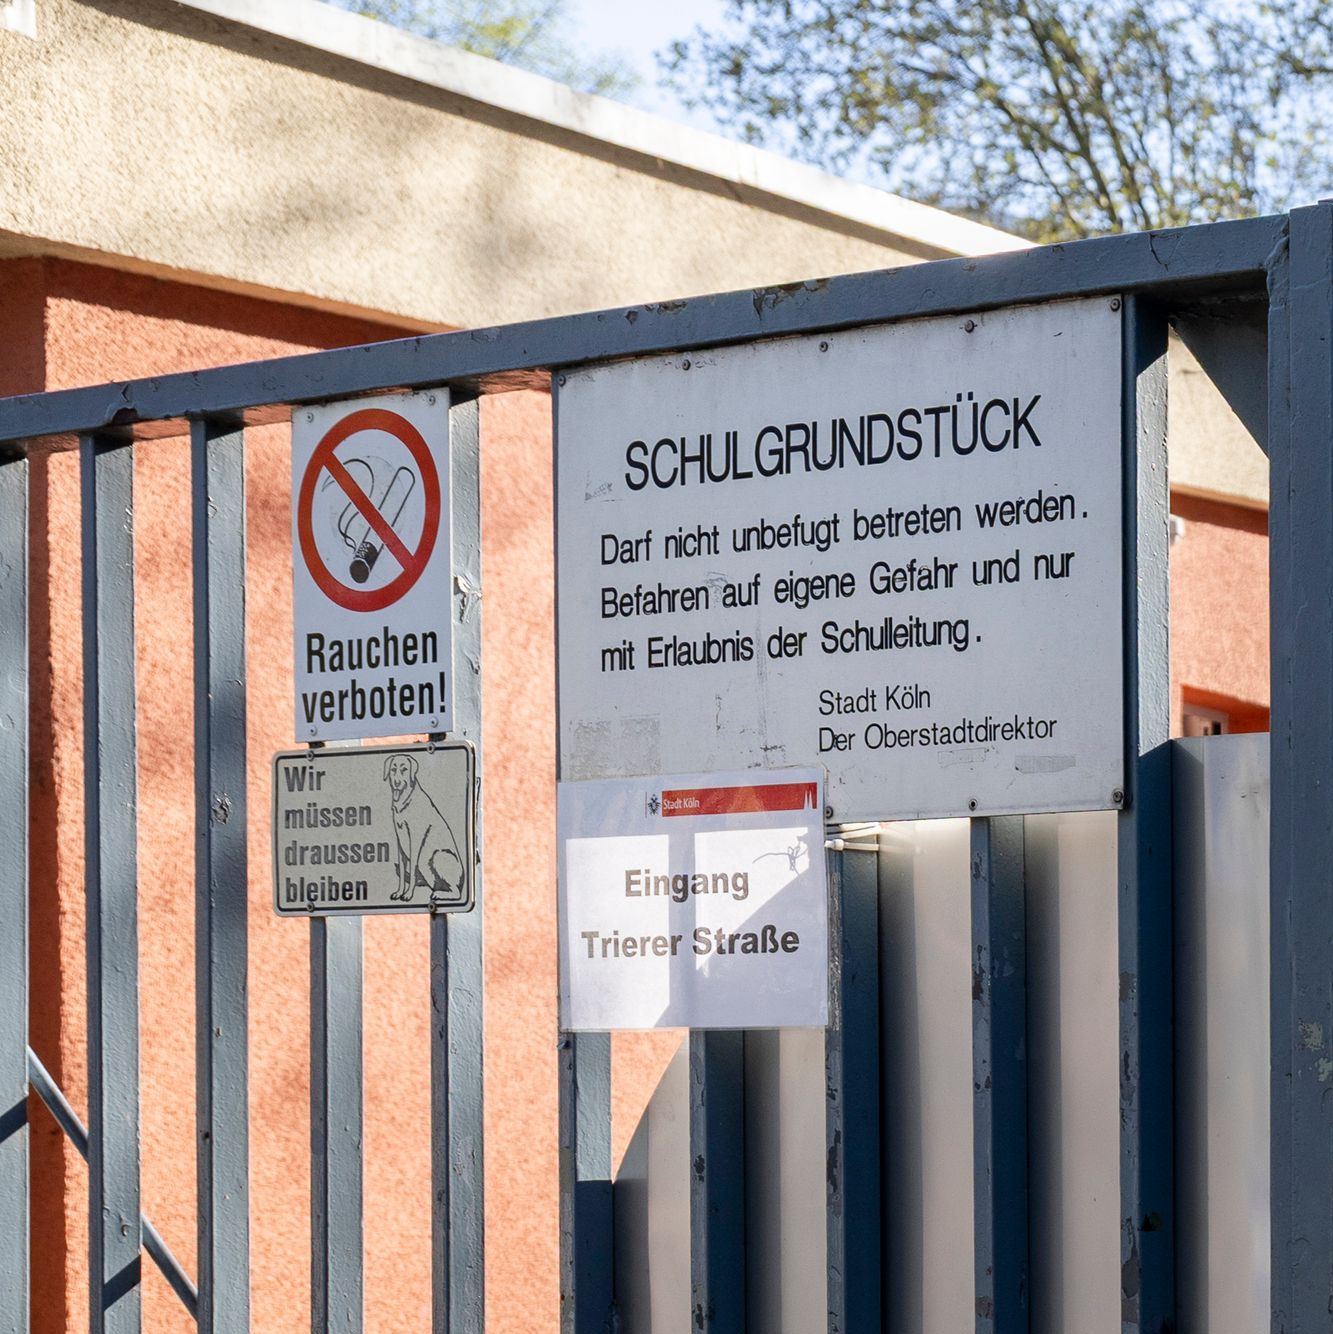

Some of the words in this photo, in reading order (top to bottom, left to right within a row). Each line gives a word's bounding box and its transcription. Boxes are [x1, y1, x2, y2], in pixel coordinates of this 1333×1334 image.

[624, 391, 1042, 491] SCHULGRUNDSTÜCK
[601, 530, 654, 566] Darf
[664, 526, 719, 558] nicht
[732, 513, 840, 553] unbefugt
[853, 503, 961, 542] betreten
[975, 490, 1088, 527] werden.
[601, 583, 709, 619] Befahren
[721, 574, 760, 608] auf
[773, 569, 855, 610] eigene
[869, 560, 958, 596] Gefahr
[971, 550, 1020, 586] und
[1034, 549, 1075, 580] nur
[306, 626, 438, 674] Rauchen
[601, 639, 635, 672] mit
[647, 627, 754, 668] Erlaubnis
[767, 627, 807, 659] der
[821, 615, 982, 654] Schulleitung.
[301, 672, 447, 723] verboten!
[818, 688, 876, 716] Stadt
[885, 685, 930, 711] Köln
[818, 726, 855, 753] Der
[864, 717, 1057, 750] Oberstadtdirektor
[283, 765, 326, 792] Wir
[284, 802, 372, 829] müssen
[663, 798, 682, 810] Stadt
[682, 798, 700, 809] Köln
[284, 838, 390, 866] draussen
[284, 876, 368, 903] bleiben
[625, 868, 749, 903] Eingang
[581, 930, 682, 959] Trierer
[692, 924, 800, 955] Straße
